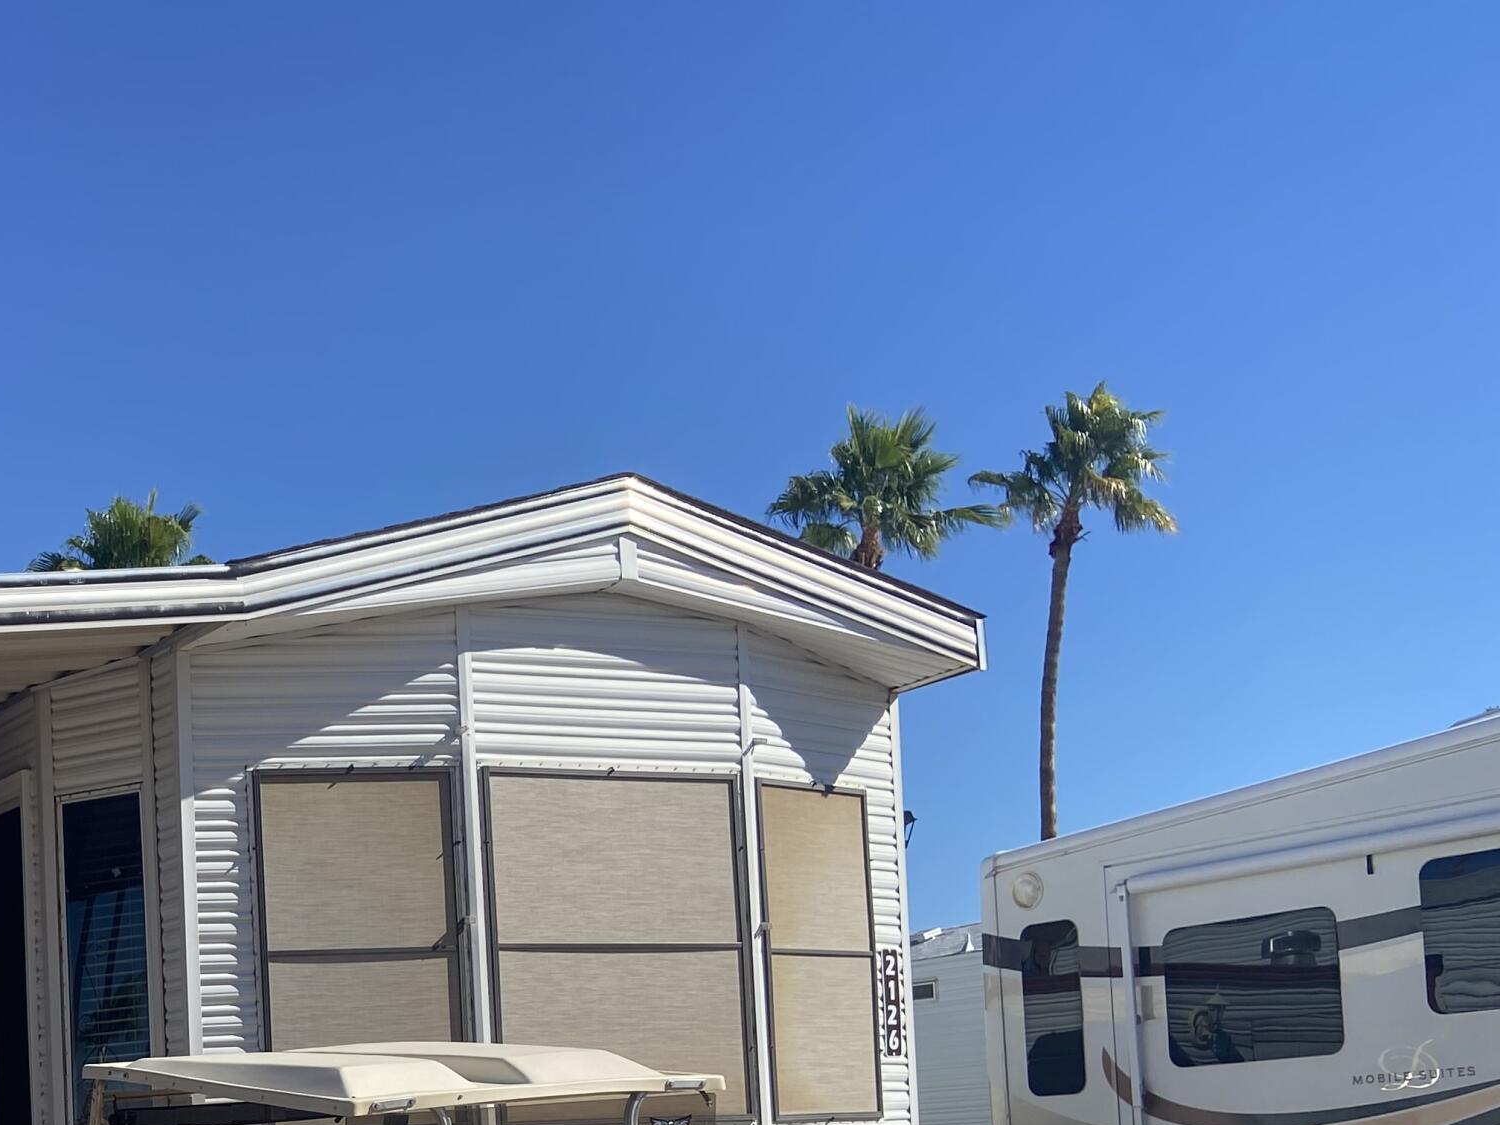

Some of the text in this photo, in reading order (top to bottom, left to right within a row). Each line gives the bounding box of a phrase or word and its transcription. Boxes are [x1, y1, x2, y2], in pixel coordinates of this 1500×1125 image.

[885, 955, 899, 1050] 2126
[1352, 1065, 1476, 1086] MOBILE SUITES
